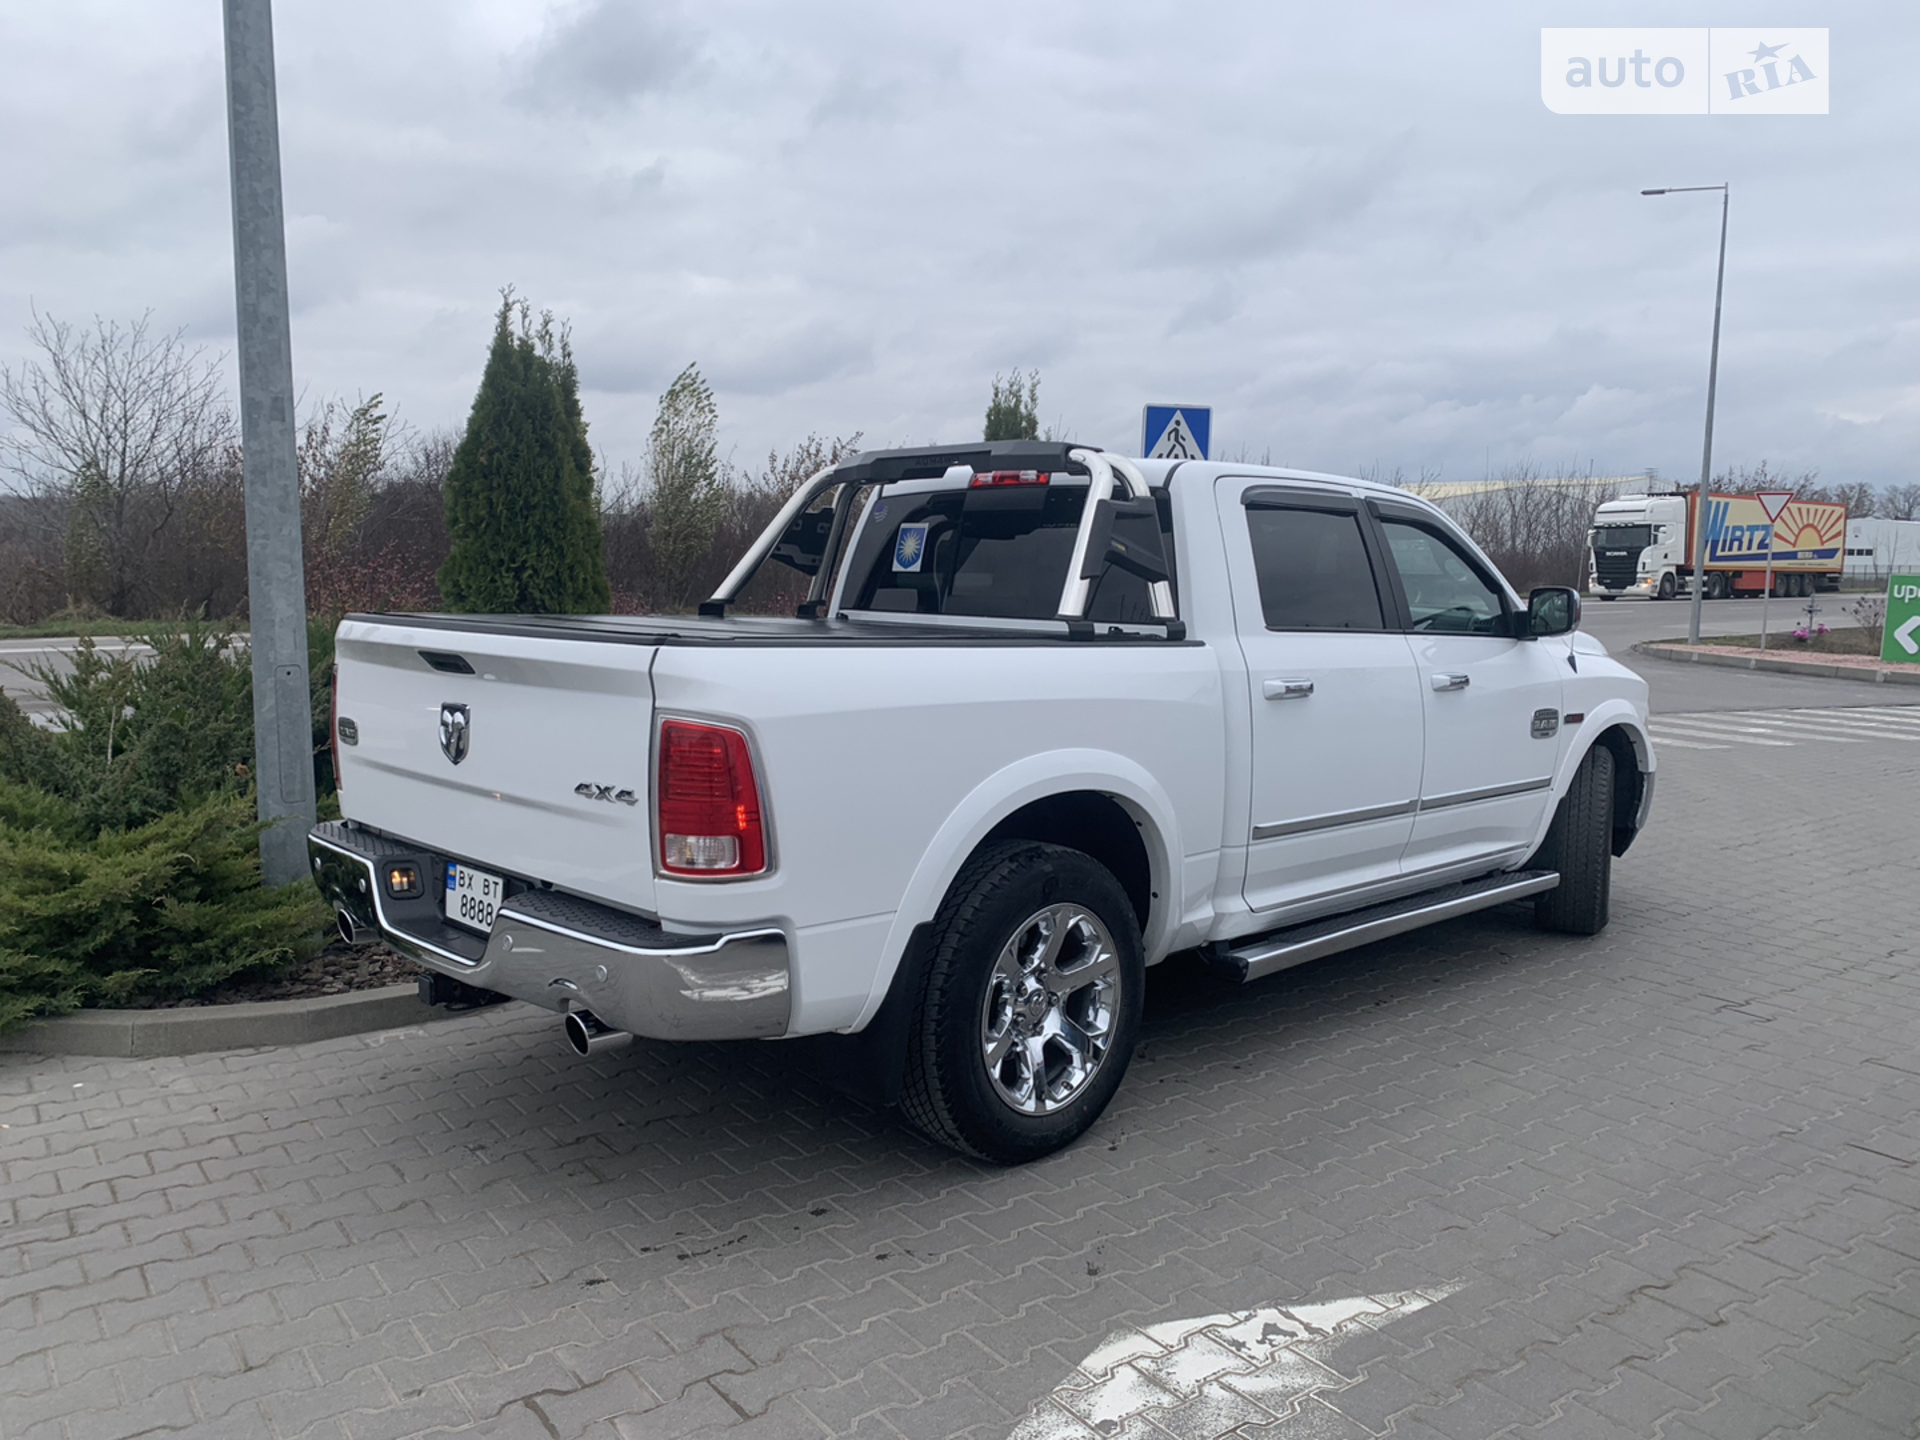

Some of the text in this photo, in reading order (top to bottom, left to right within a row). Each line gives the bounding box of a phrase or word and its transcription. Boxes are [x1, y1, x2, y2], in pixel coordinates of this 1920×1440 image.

[1705, 500, 1771, 562] WIRTZ
[1893, 584, 1920, 603] up
[458, 870, 499, 899] BX BT
[460, 894, 494, 927] 8888
